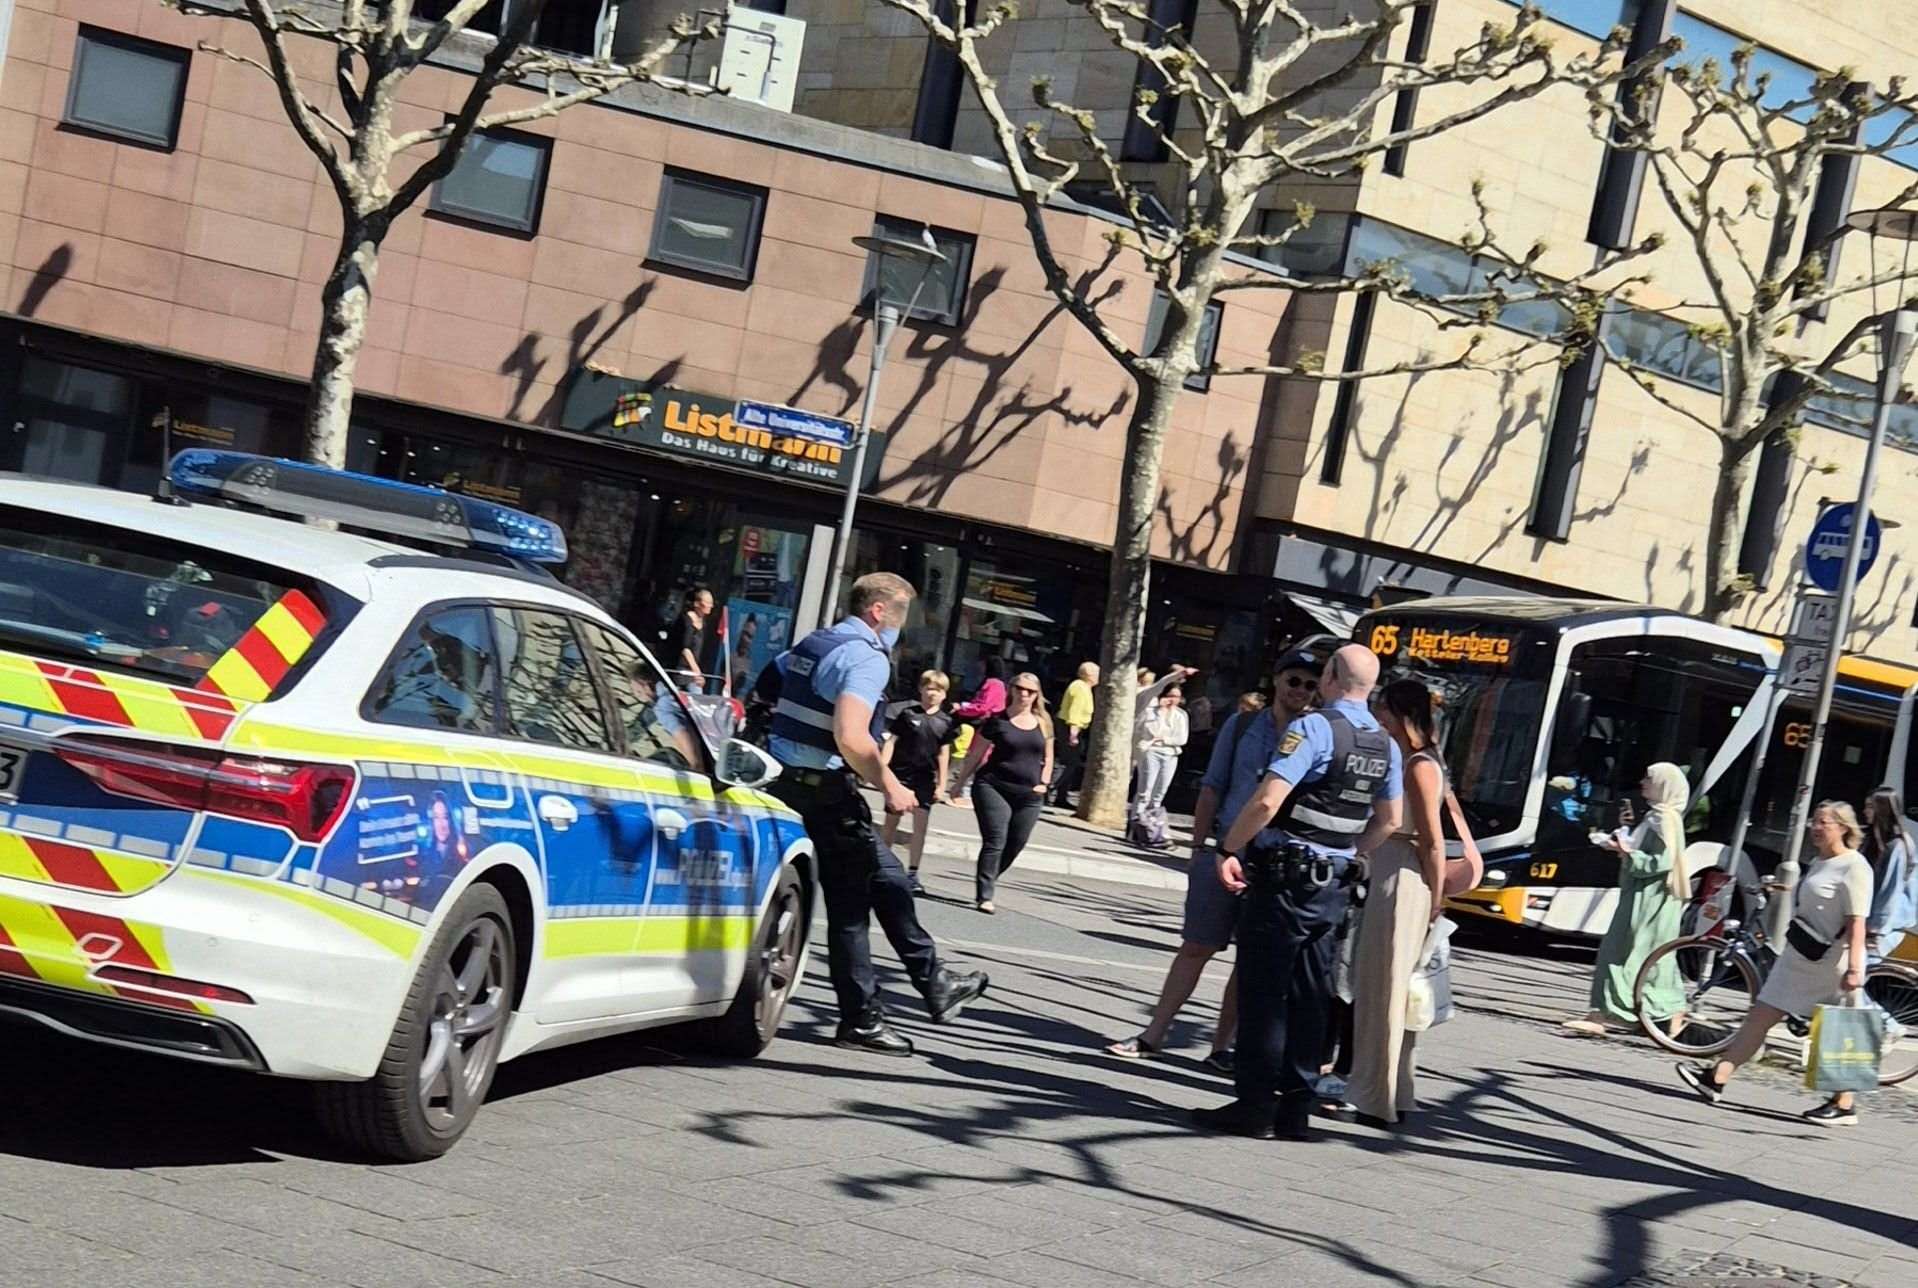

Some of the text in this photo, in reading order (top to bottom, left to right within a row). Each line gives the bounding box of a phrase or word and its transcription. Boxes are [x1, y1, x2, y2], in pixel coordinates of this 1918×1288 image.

[664, 400, 842, 463] Listmann
[661, 431, 839, 479] Das Haus für Kreative
[1371, 625, 1510, 655] 65 Hartenberg
[1344, 753, 1387, 778] POLIZEI
[1529, 862, 1559, 879] 617
